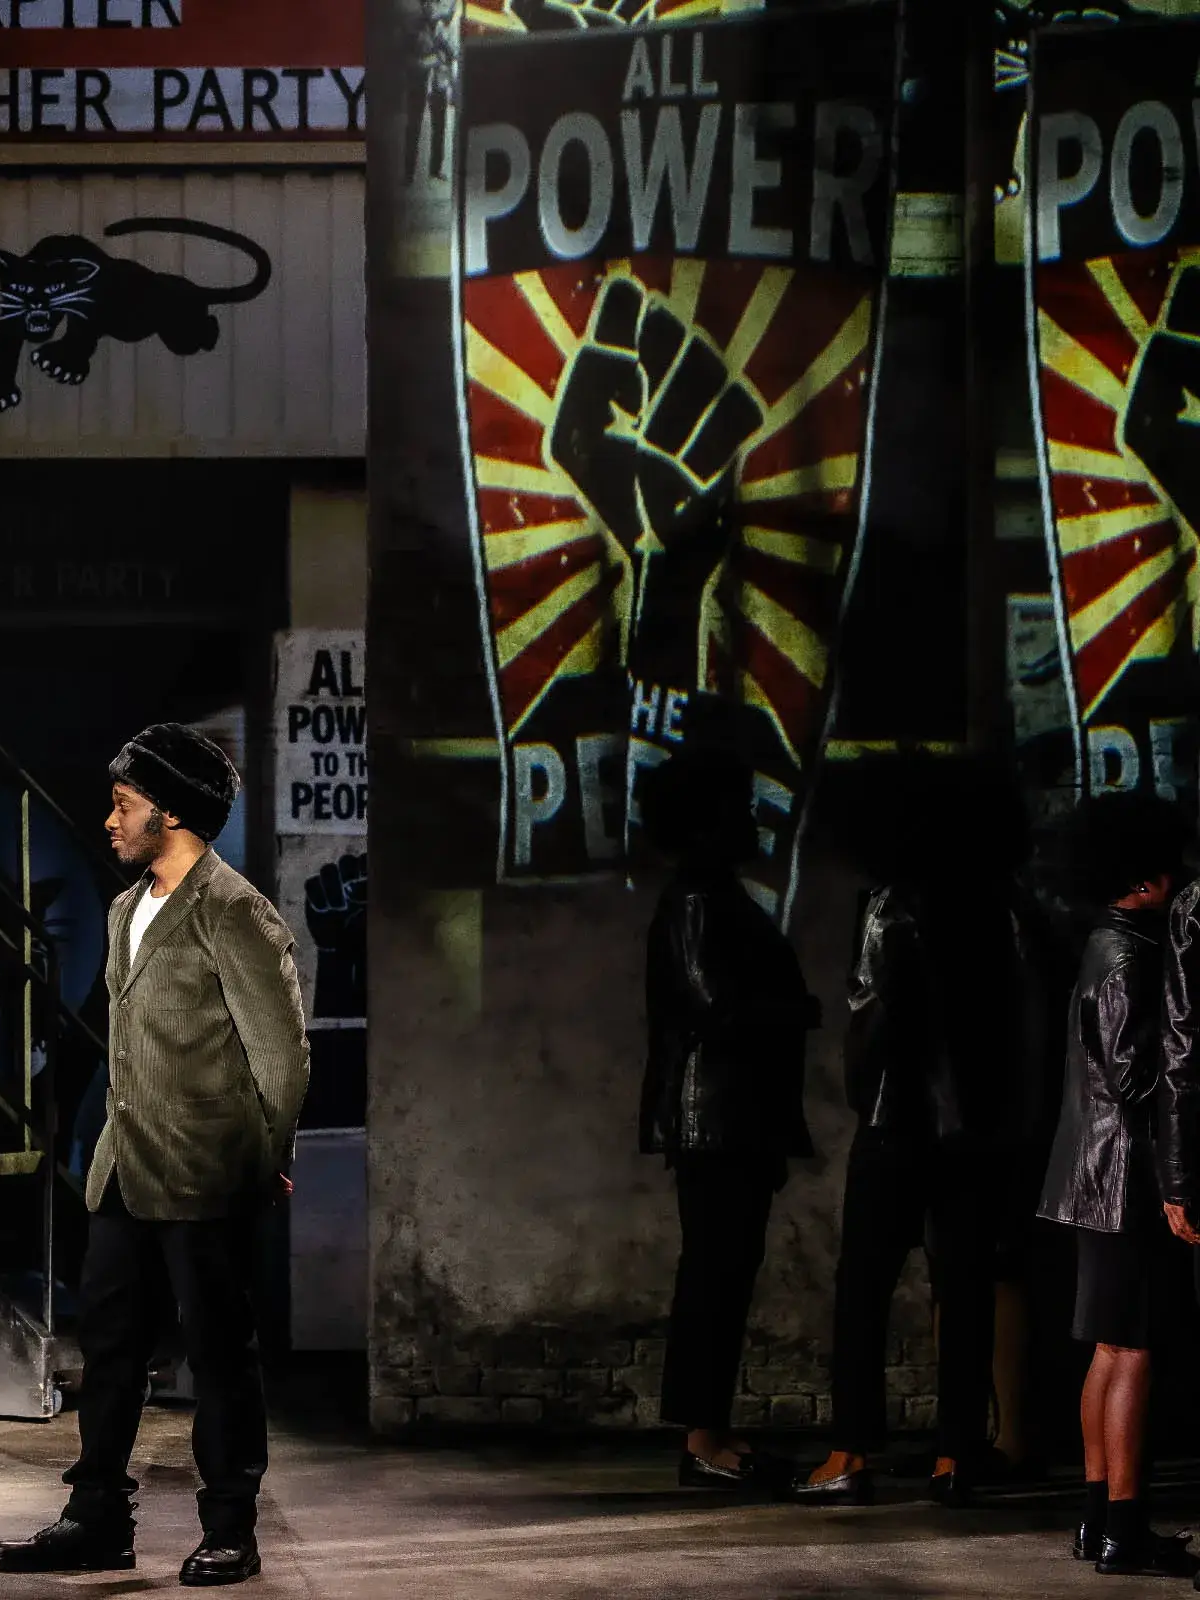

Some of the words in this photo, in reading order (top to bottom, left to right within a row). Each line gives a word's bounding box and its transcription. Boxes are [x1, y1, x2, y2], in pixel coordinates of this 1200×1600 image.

[622, 31, 719, 99] ALL
[154, 68, 366, 131] PARTY
[465, 102, 883, 276] POWER
[625, 668, 689, 743] HE
[311, 752, 338, 776] TO
